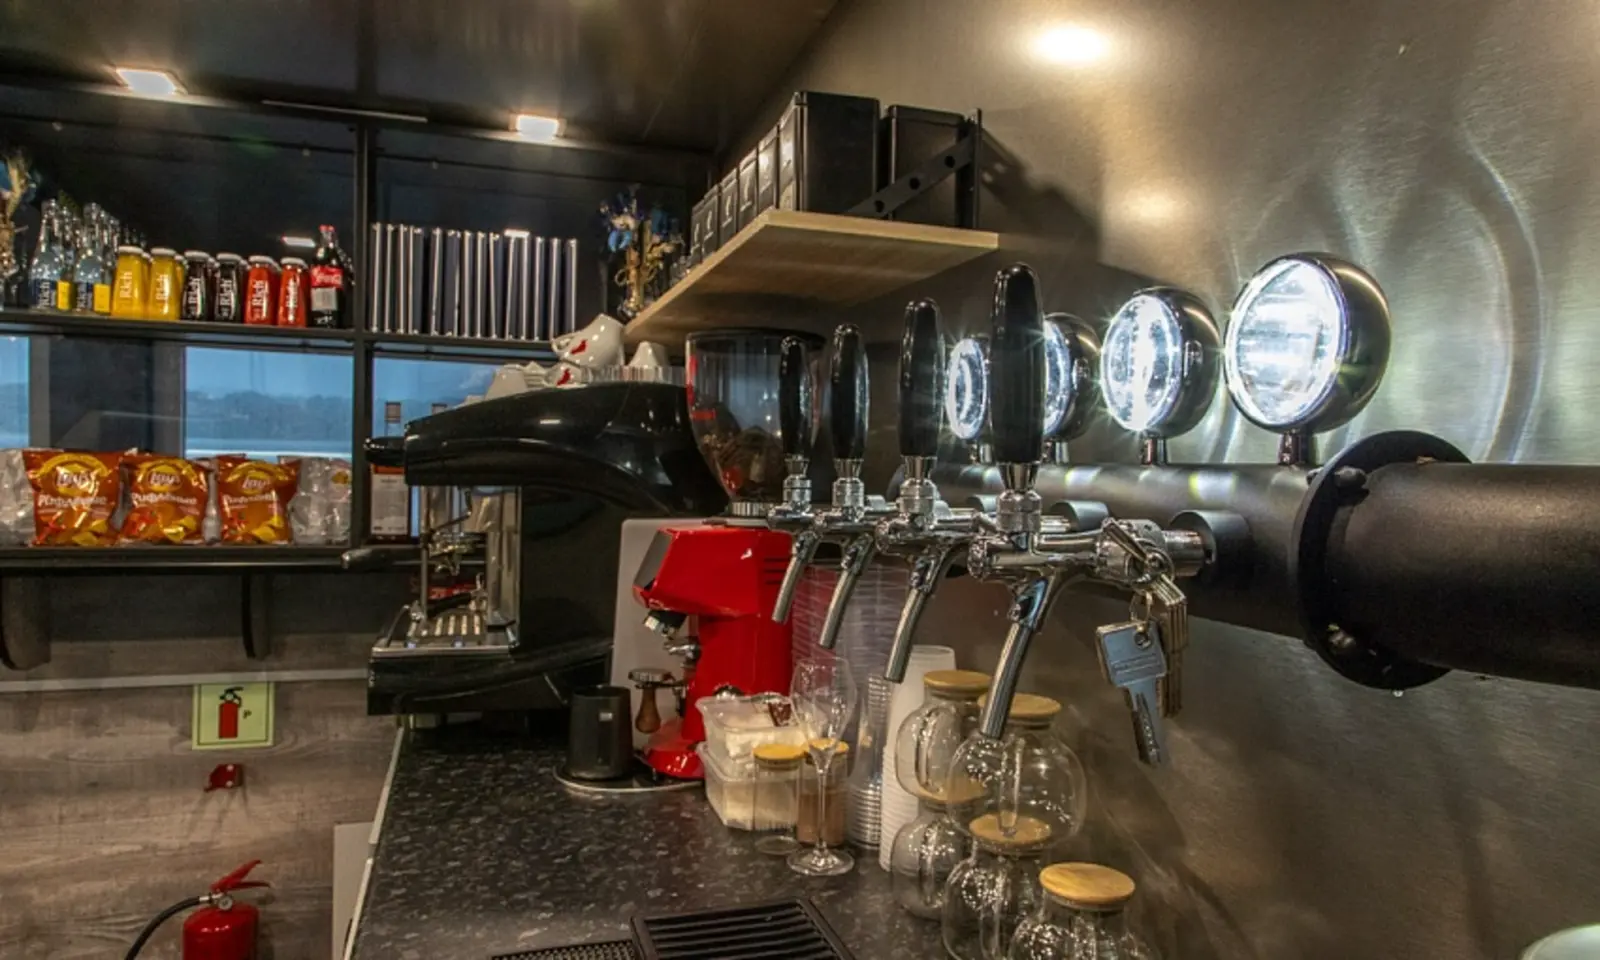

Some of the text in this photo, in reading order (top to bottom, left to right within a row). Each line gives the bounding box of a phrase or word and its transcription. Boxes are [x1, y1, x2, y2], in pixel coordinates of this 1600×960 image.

[119, 272, 132, 297] Rich
[155, 274, 168, 300] Rich
[188, 276, 200, 304] Rich
[220, 278, 232, 305] Rich
[252, 279, 266, 306] Rich
